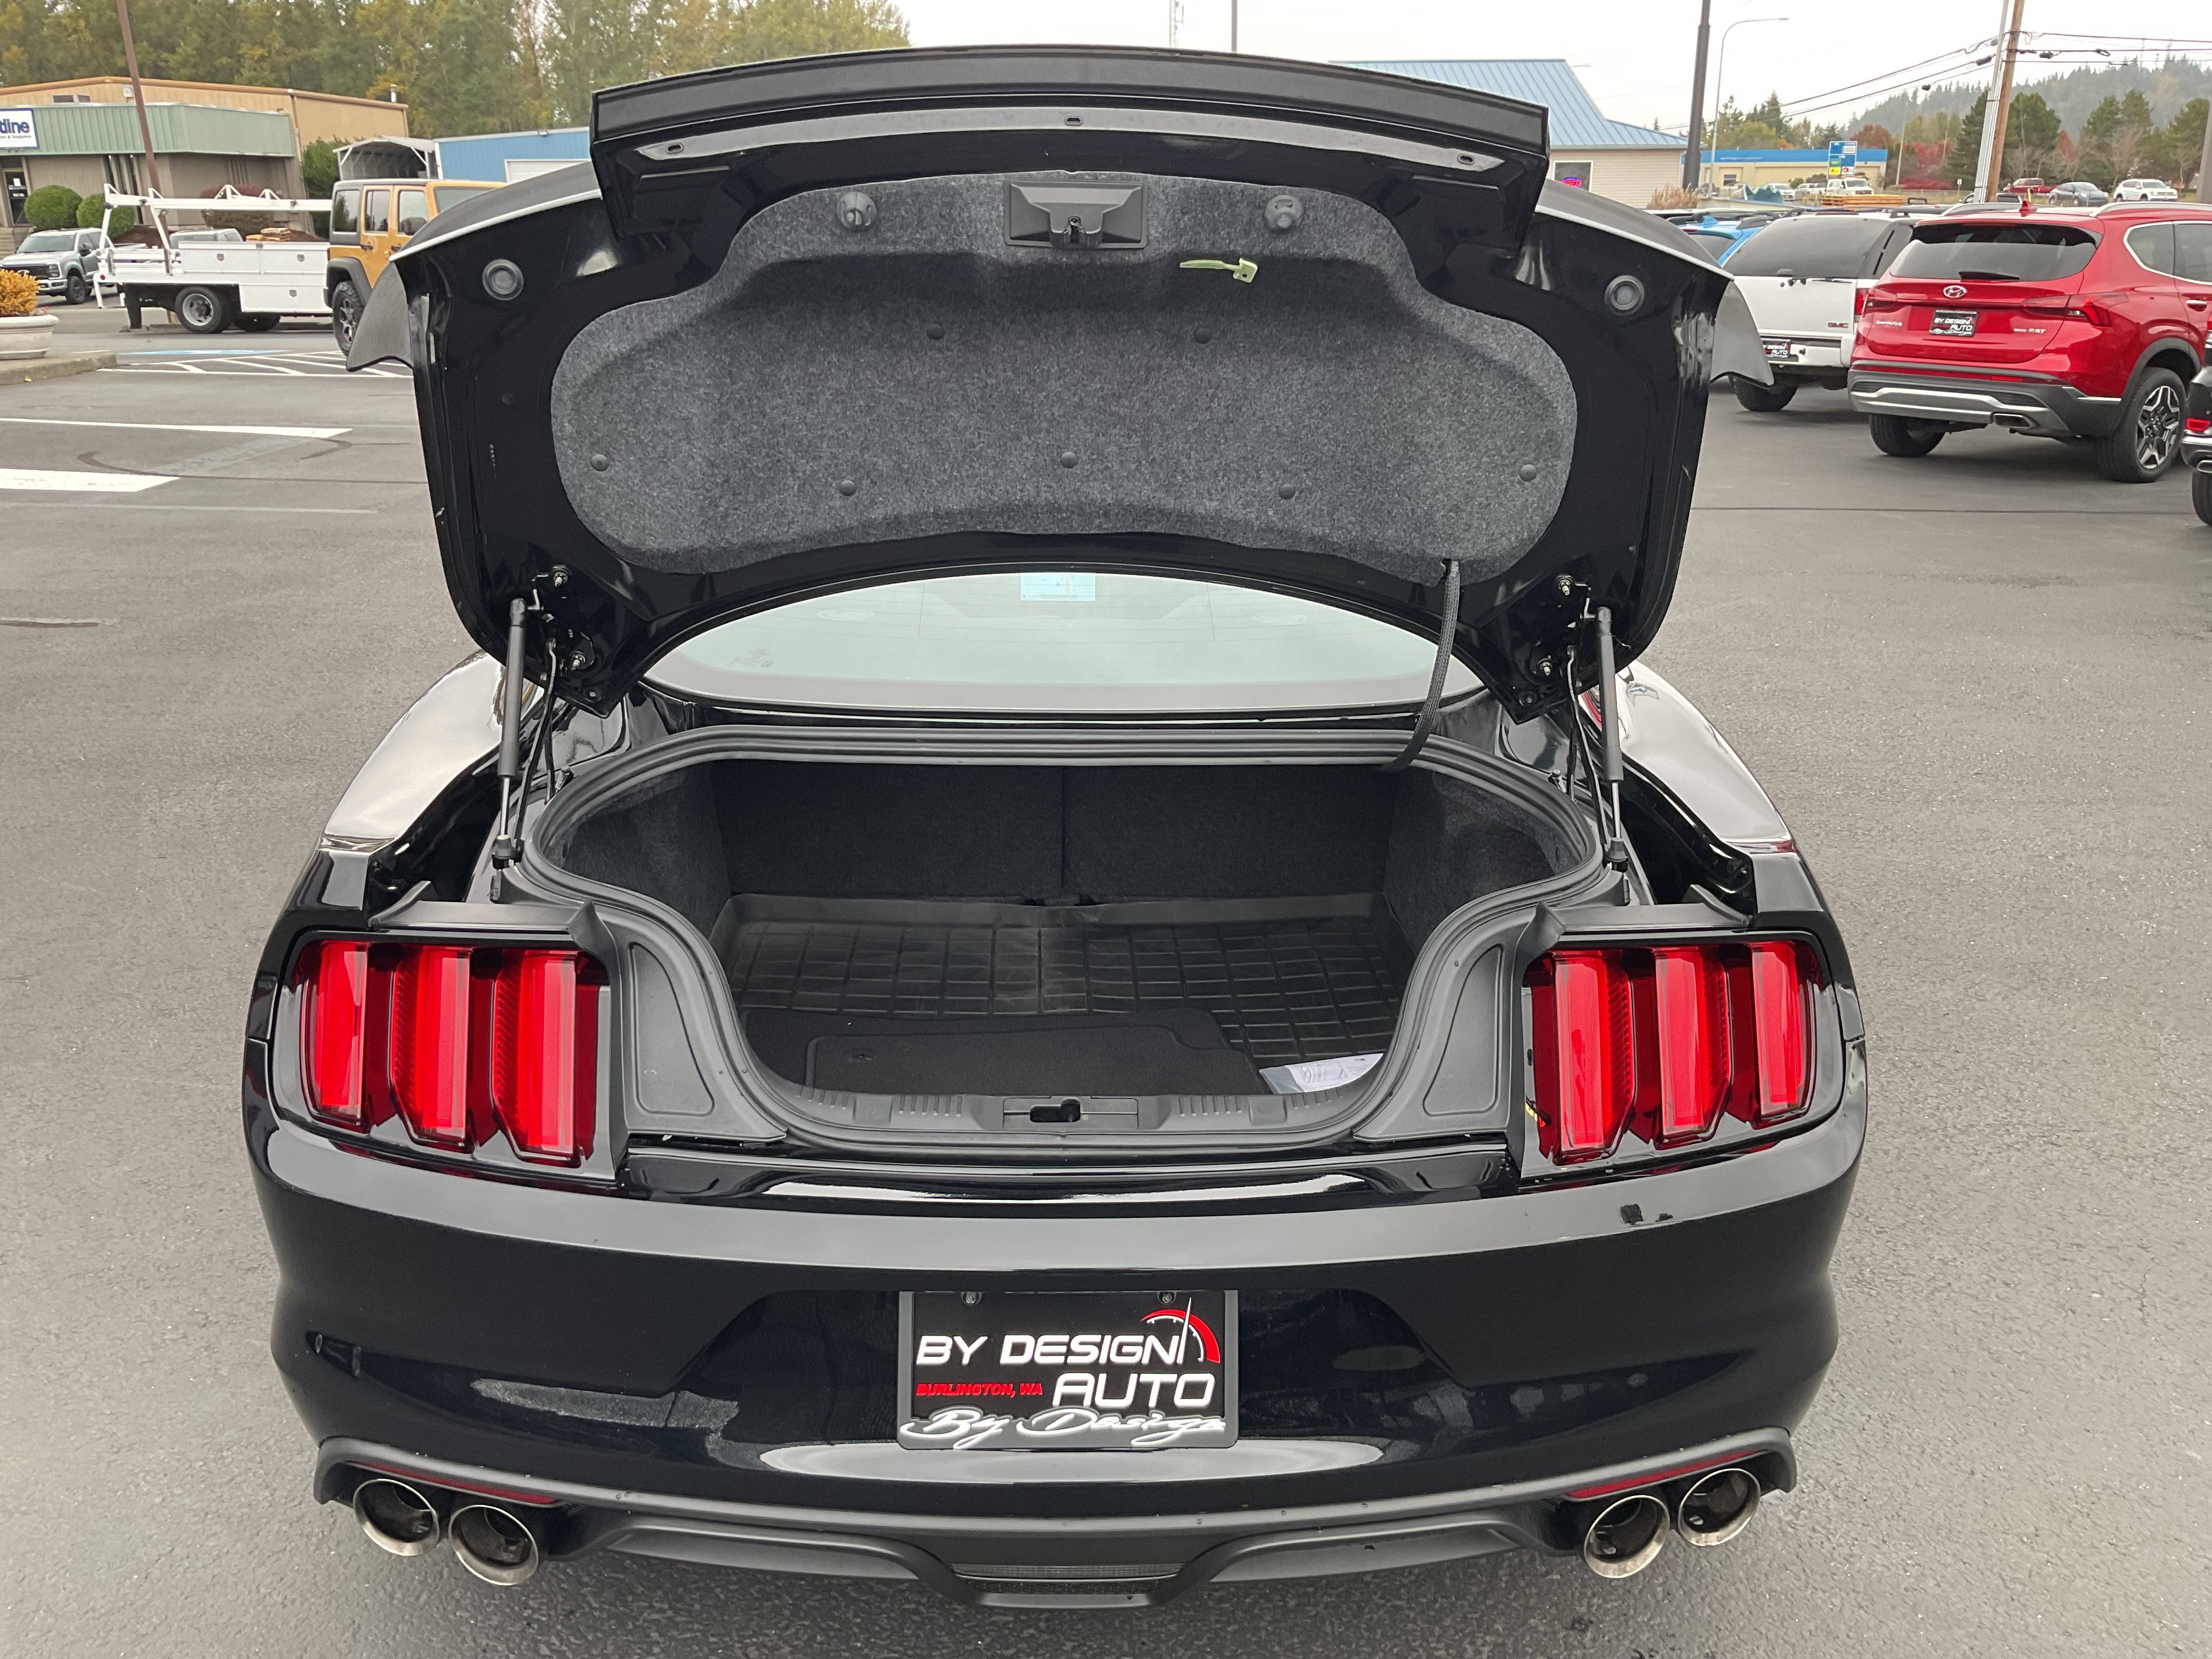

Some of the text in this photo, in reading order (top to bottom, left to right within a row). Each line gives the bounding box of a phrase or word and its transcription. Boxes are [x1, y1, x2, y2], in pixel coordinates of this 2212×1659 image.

[916, 1335, 1180, 1365] BY DESIGN
[916, 1383, 1042, 1398] BURLINGTON, WA
[1052, 1373, 1215, 1408] AUTO
[900, 1409, 1226, 1449] By Design
